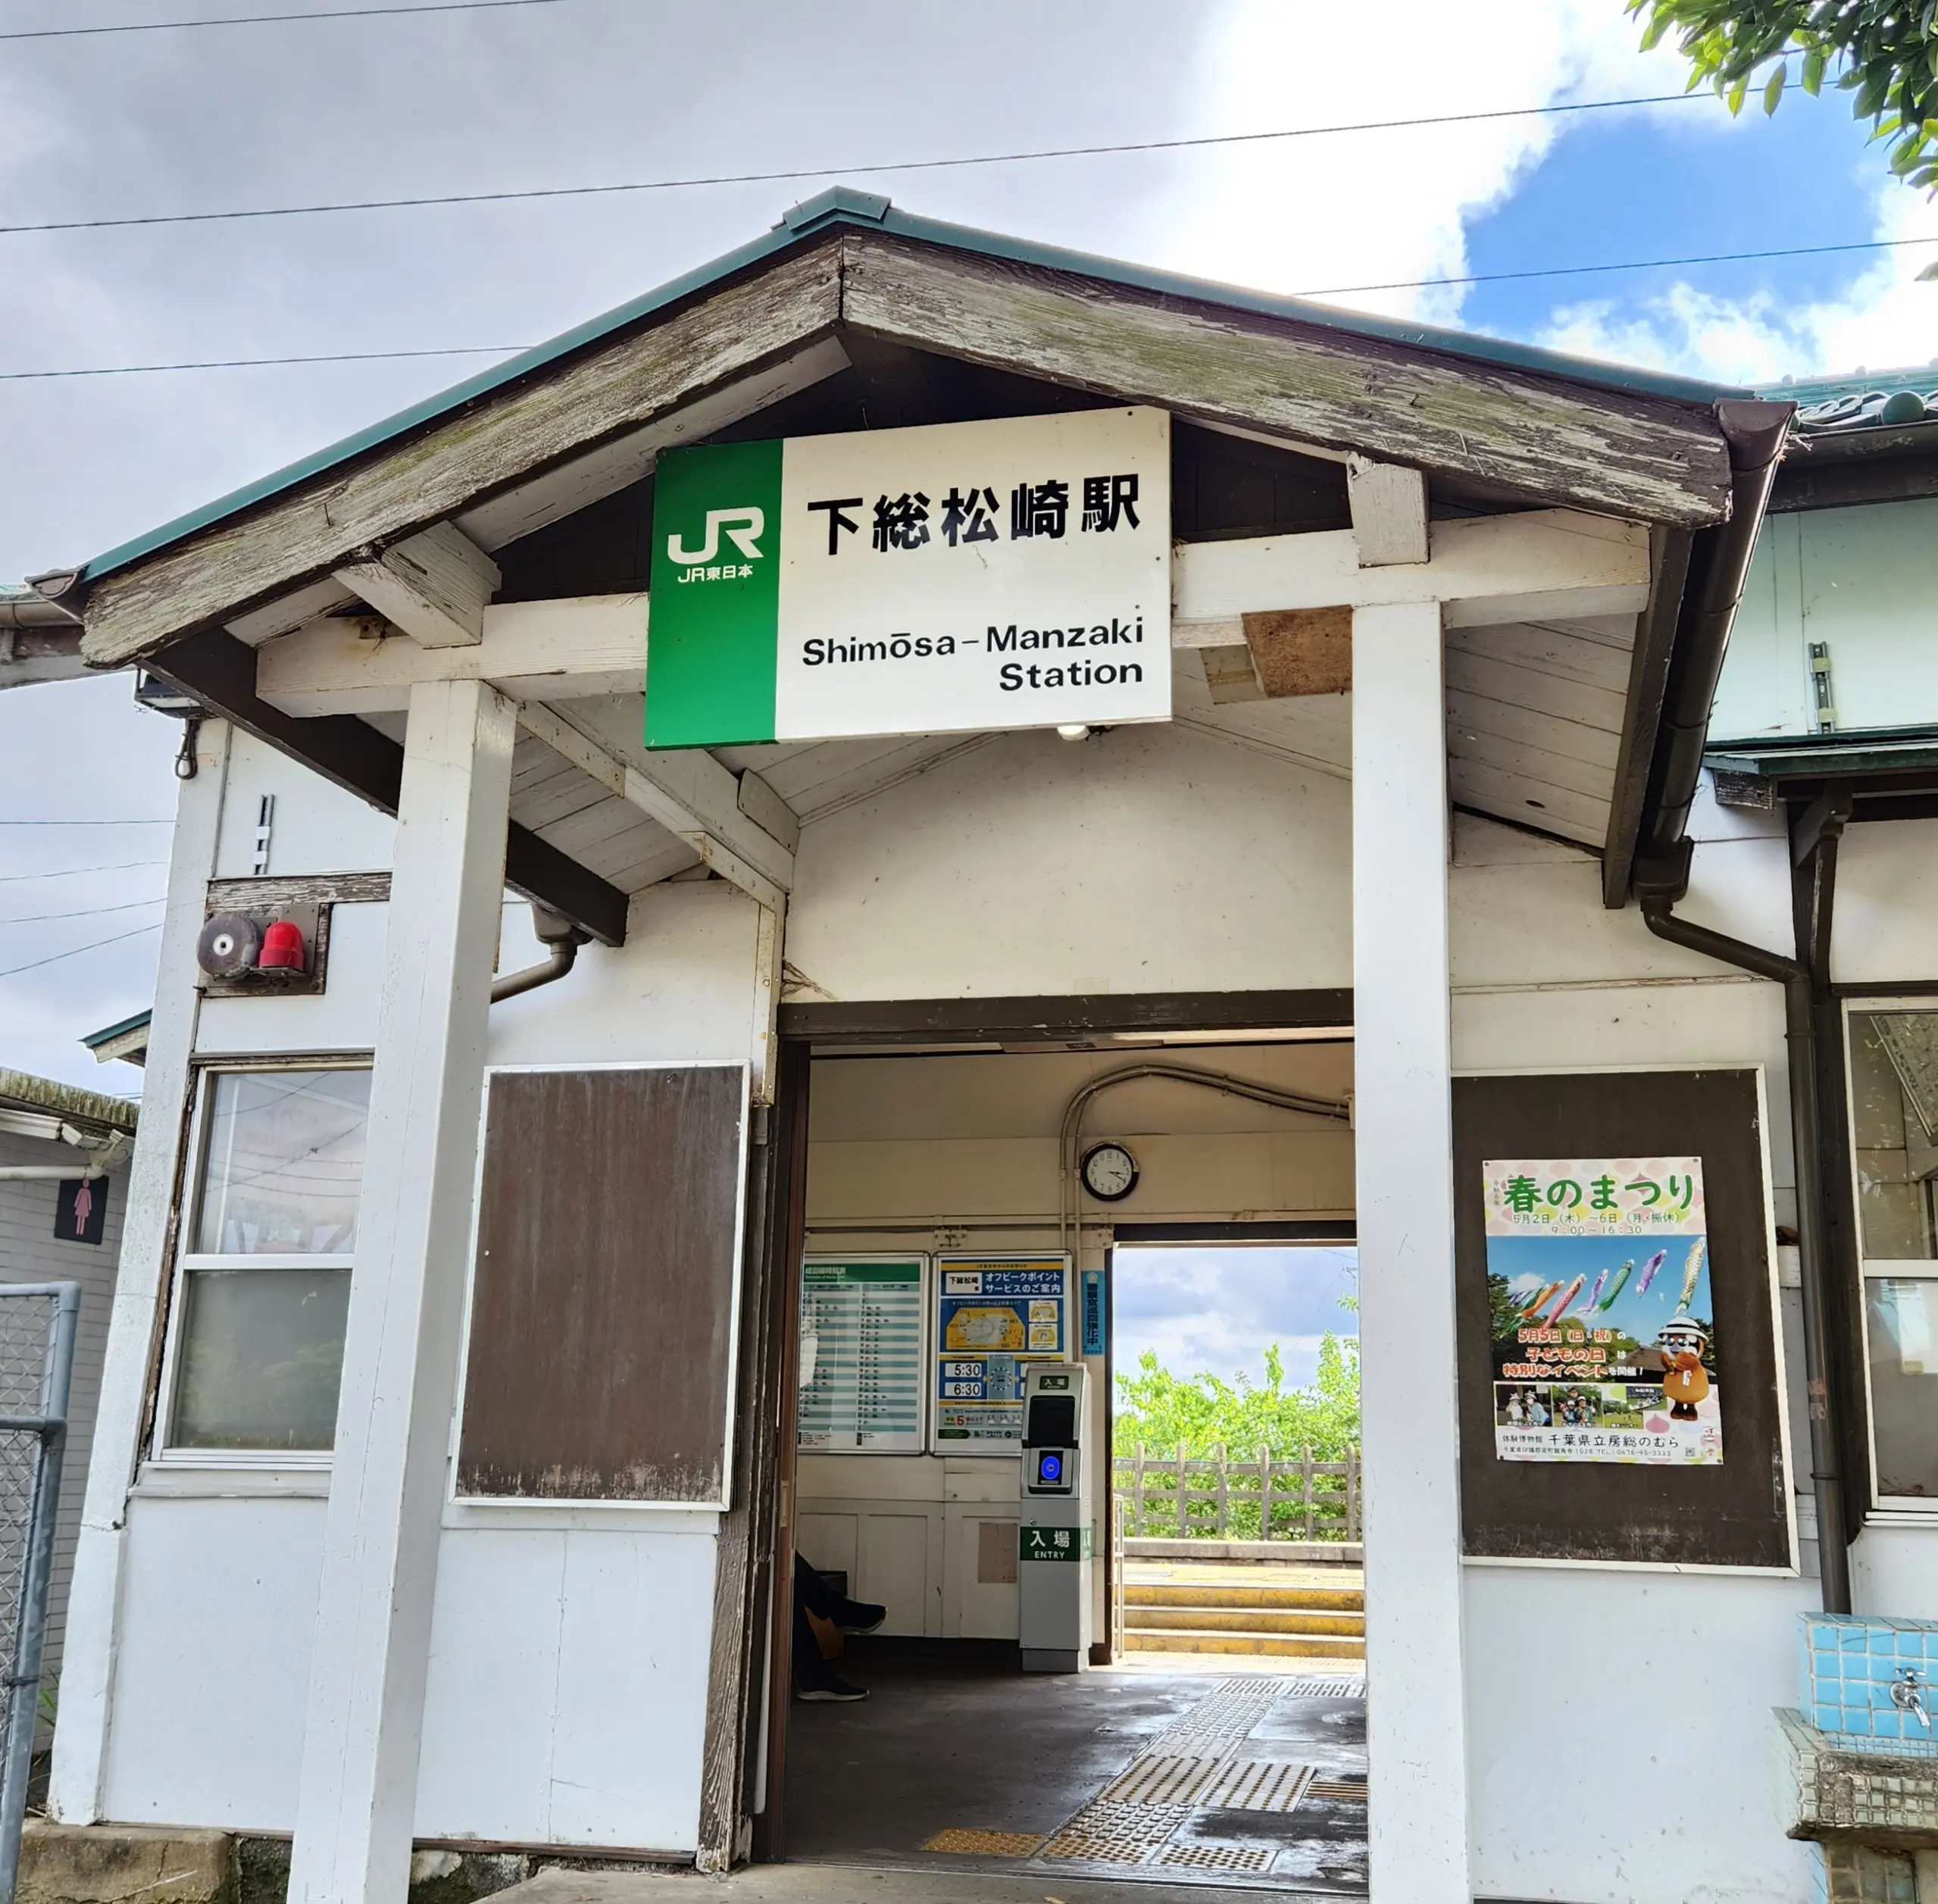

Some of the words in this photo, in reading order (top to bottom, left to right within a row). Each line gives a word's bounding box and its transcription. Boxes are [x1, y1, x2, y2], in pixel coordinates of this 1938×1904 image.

[808, 474, 1140, 555] 下総松崎駅
[668, 507, 764, 564] JR
[677, 564, 753, 583] JR東日本
[1000, 661, 1142, 691] Station
[1504, 1175, 1693, 1212] 春のまつり
[986, 1272, 1060, 1282] オフピークポイント
[986, 1283, 1061, 1293] サービスのご案内
[955, 1365, 980, 1376] 5:30
[954, 1383, 980, 1395] 6:30
[1549, 1434, 1678, 1448] 千葉県立房総のむら
[1030, 1530, 1070, 1548] 入場
[1034, 1550, 1065, 1559] ENTRY
